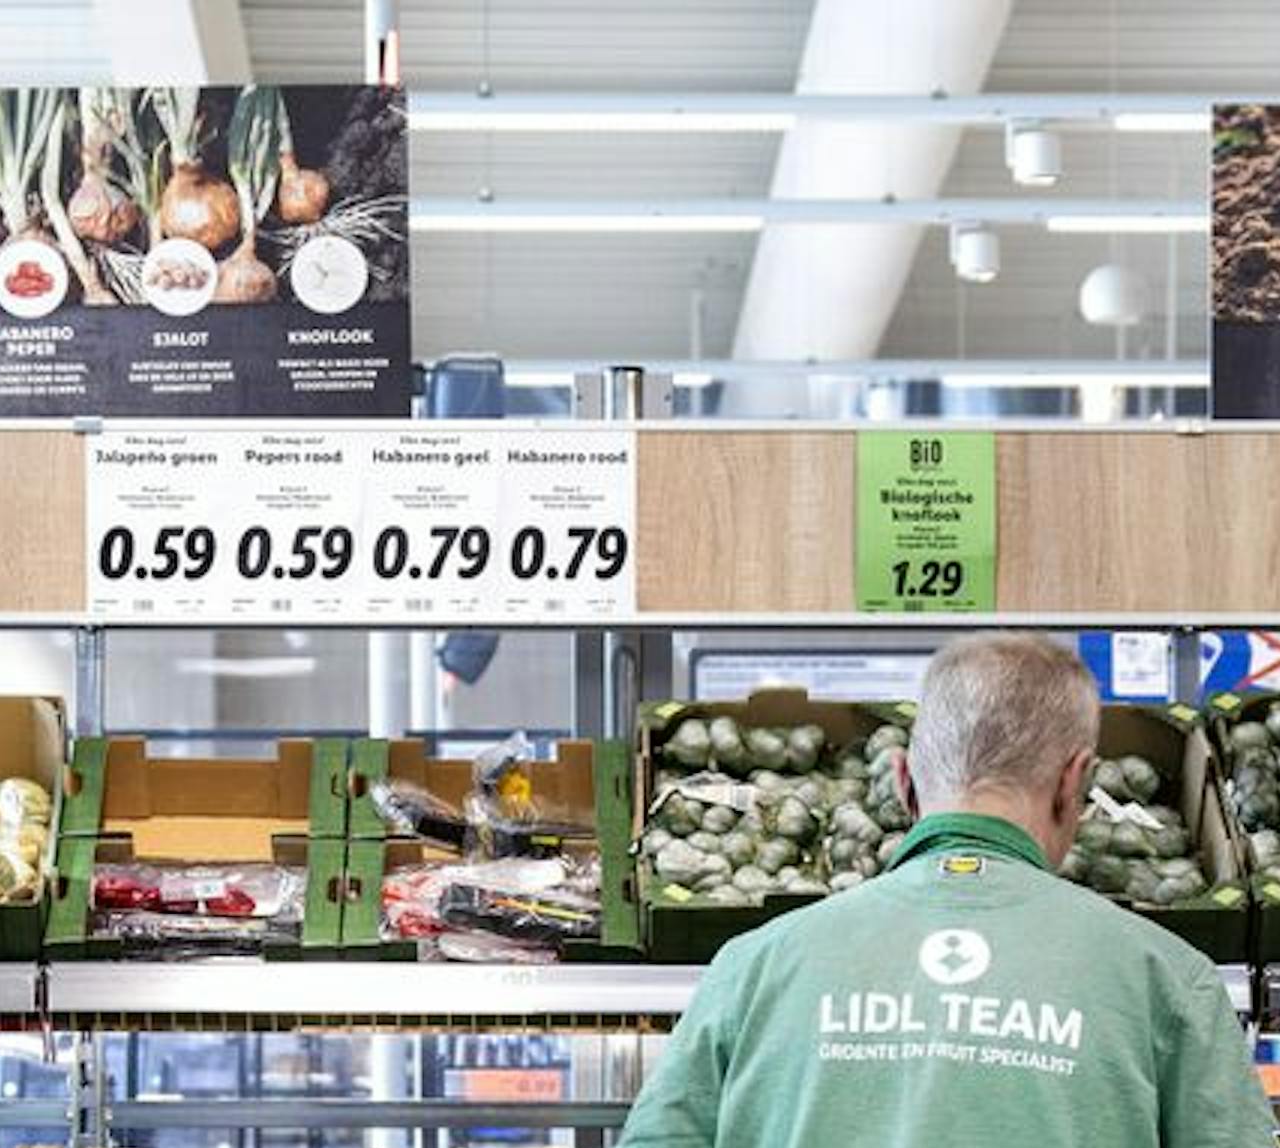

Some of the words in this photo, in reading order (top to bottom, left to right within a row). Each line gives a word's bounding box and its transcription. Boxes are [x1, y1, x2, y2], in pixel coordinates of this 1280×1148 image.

[152, 331, 210, 348] SJALOT
[287, 329, 375, 345] KNOFLOOK
[6, 341, 56, 356] PEPER
[96, 449, 166, 466] Jalapeño
[170, 452, 218, 467] groen
[245, 449, 300, 466] Pepers
[304, 449, 344, 464] rood
[373, 449, 451, 464] Habanero
[454, 449, 490, 467] geel
[507, 449, 586, 464] Habanero
[589, 449, 628, 464] rood
[880, 489, 974, 506] Biologische
[891, 508, 962, 522] knoflook
[99, 526, 217, 580] 0.59
[237, 526, 354, 580] 0.59
[373, 526, 491, 580] 0.79
[510, 526, 628, 580] 0.79
[892, 560, 963, 597] 1.29
[819, 993, 926, 1034] LIDL
[939, 993, 1083, 1049] TEAM
[819, 1042, 898, 1061] GROENTE
[900, 1043, 925, 1058] EN
[978, 1046, 1077, 1075] SPECIALIST
